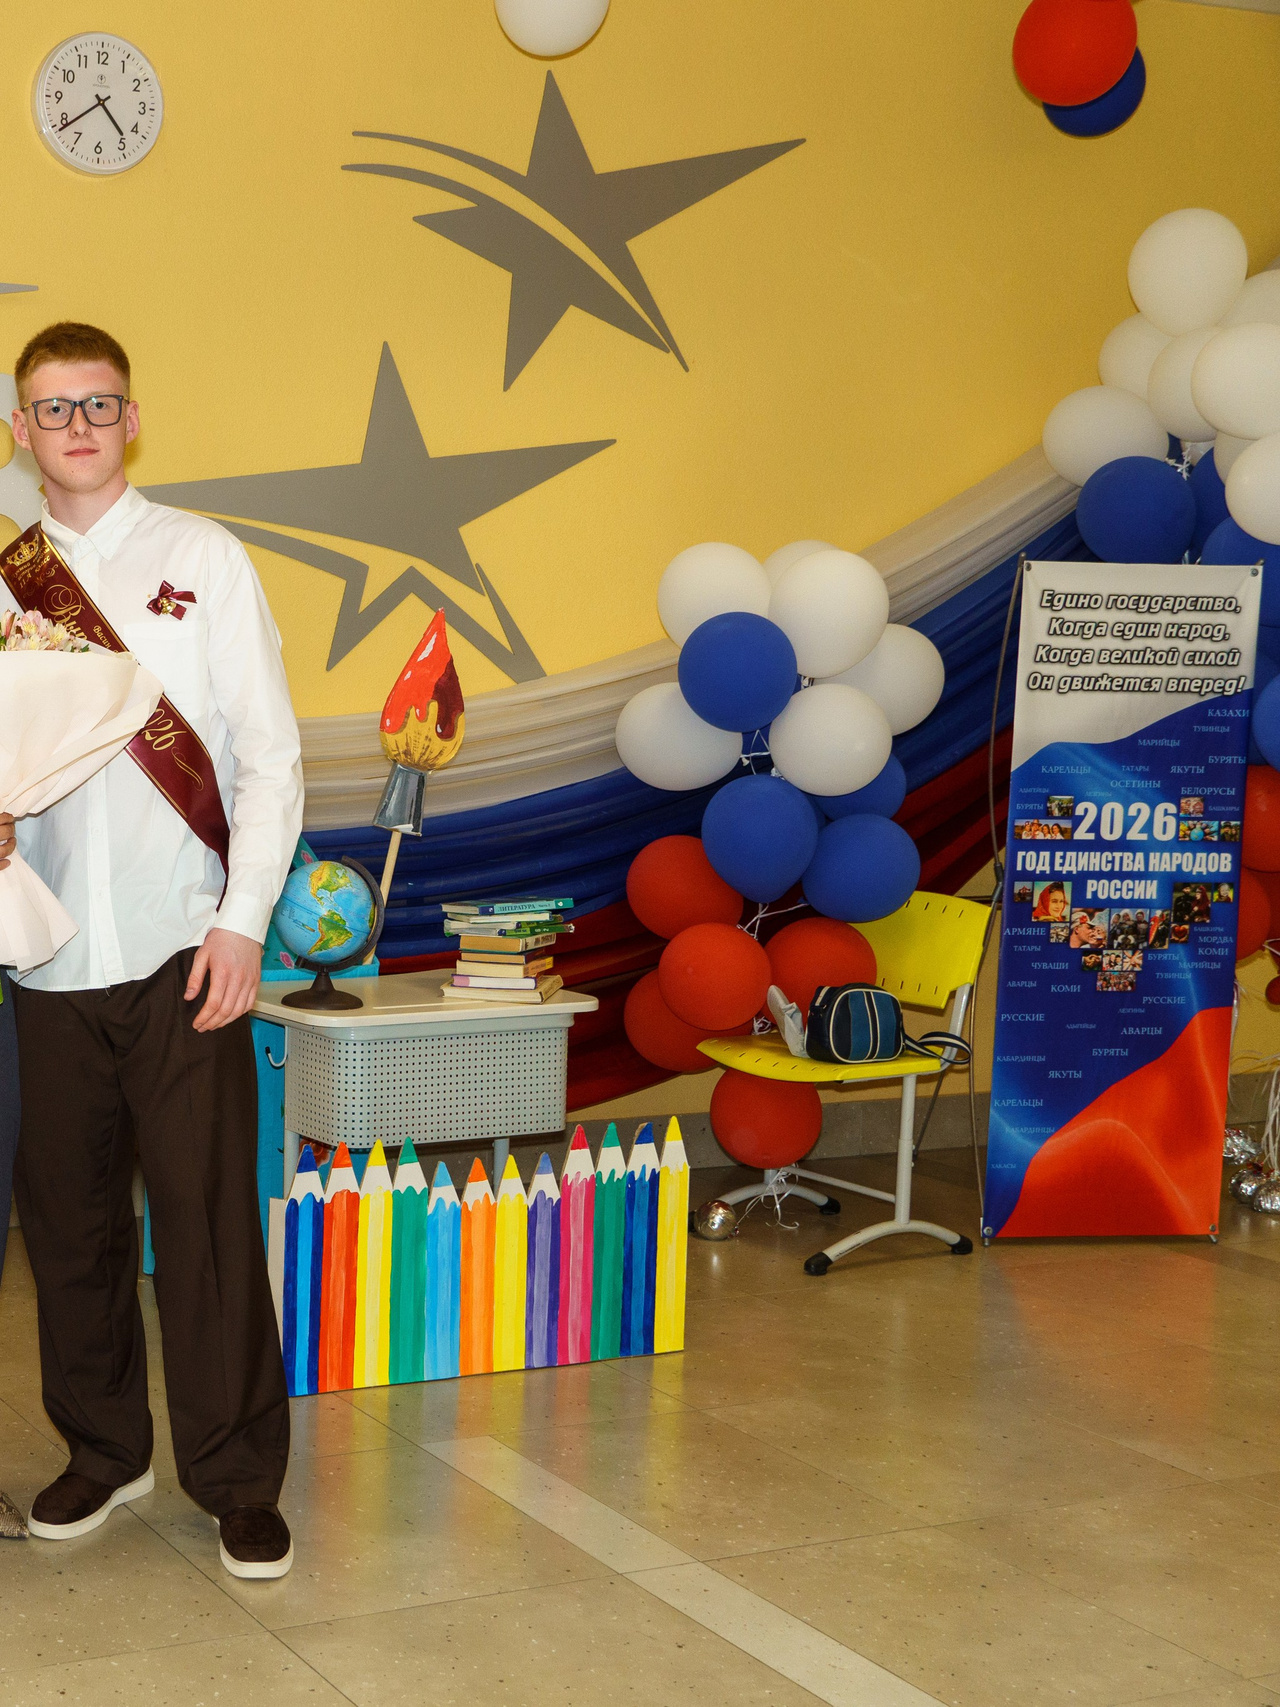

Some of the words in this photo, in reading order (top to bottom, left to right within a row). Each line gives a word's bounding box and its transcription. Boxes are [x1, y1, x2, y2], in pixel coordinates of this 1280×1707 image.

[77, 54, 88, 69] 11
[96, 50, 109, 66] 12
[121, 60, 125, 74] 1
[62, 69, 75, 84] 10
[132, 78, 141, 93] 2
[54, 90, 63, 105] 9
[138, 101, 147, 116] 3
[60, 112, 69, 127] 8
[130, 121, 139, 135] 4
[73, 131, 83, 145] 7
[94, 141, 103, 155] 6
[117, 137, 126, 151] 5
[1040, 589, 1103, 611] Едино
[1106, 594, 1242, 614] государство,
[1048, 617, 1108, 640] Когда
[1111, 621, 1162, 640] един
[1164, 623, 1231, 642] народ,
[1034, 645, 1095, 667] Когда
[1098, 646, 1179, 665] великой
[1182, 648, 1241, 666] силой
[1027, 671, 1055, 690] Он
[1057, 673, 1162, 693] движется
[1165, 675, 1247, 696] вперед!
[1207, 708, 1250, 717] КАЗАХИ
[1193, 725, 1230, 733] ТУВИНЦЫ
[1138, 739, 1180, 747] МАРИЙЦЫ
[1208, 755, 1247, 764] БУРЯТЫ
[1041, 765, 1091, 775] КАРЕЛЬЦЫ
[1170, 765, 1205, 774] ЯКУТЫ
[1110, 780, 1161, 789] ОСЕТИНЫ
[1180, 786, 1236, 796] БЕЛОРУСЫ
[1073, 801, 1178, 842] 2026
[1016, 850, 1050, 874] ГОД
[1054, 851, 1145, 874] ЕДИНСТВА
[1148, 852, 1232, 876] НАРОДОВ
[1086, 879, 1158, 900] РОССИИ
[498, 903, 536, 912] ЛИТЕРАТУРА
[1003, 927, 1046, 936] АРМЯНЕ
[1198, 936, 1234, 944] МОРДВА
[1198, 947, 1229, 956] КОМИ
[1147, 953, 1180, 961] БУРЯТЫ
[1031, 962, 1069, 970] ЧУВАШИ
[1178, 961, 1221, 970] МАРИЙЦЫ
[1155, 972, 1192, 980] ТУВИНЦЫ
[1050, 984, 1081, 993] КОМИ
[1142, 996, 1186, 1004] РУССКИЕ
[1001, 1013, 1045, 1022] РУССКИЕ
[1121, 1027, 1163, 1035] АВАРЦЫ
[1092, 1048, 1129, 1056] БУРЯТЫ
[1048, 1070, 1082, 1079] ЯКУТЫ
[994, 1099, 1043, 1107] КАРЕЛЬЦЫ
